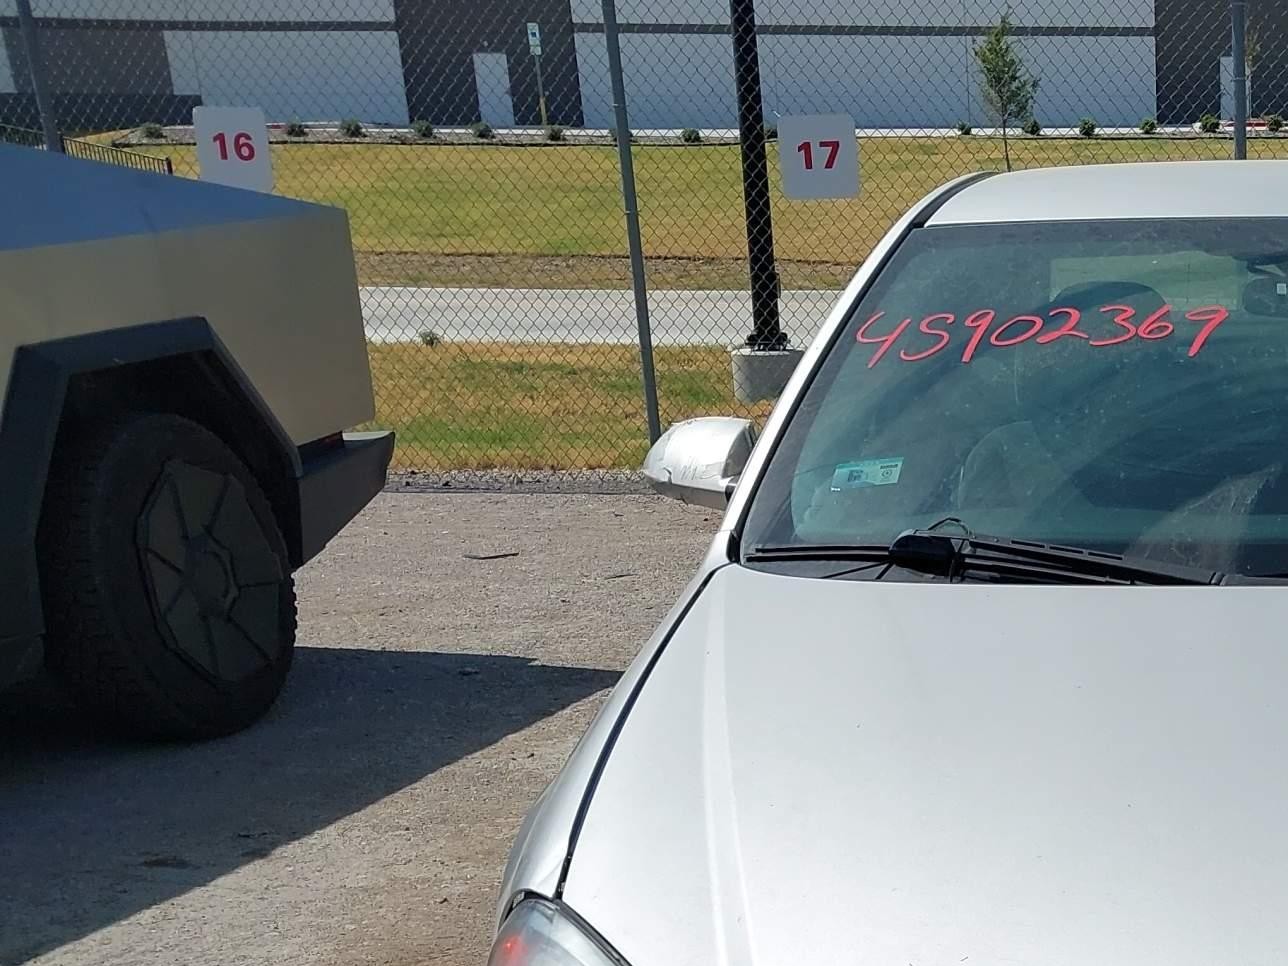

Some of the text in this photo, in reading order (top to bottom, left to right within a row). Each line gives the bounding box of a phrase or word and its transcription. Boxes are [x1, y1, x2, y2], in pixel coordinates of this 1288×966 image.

[212, 132, 255, 161] 16
[797, 141, 840, 170] 17
[856, 304, 1229, 369] 45902369
